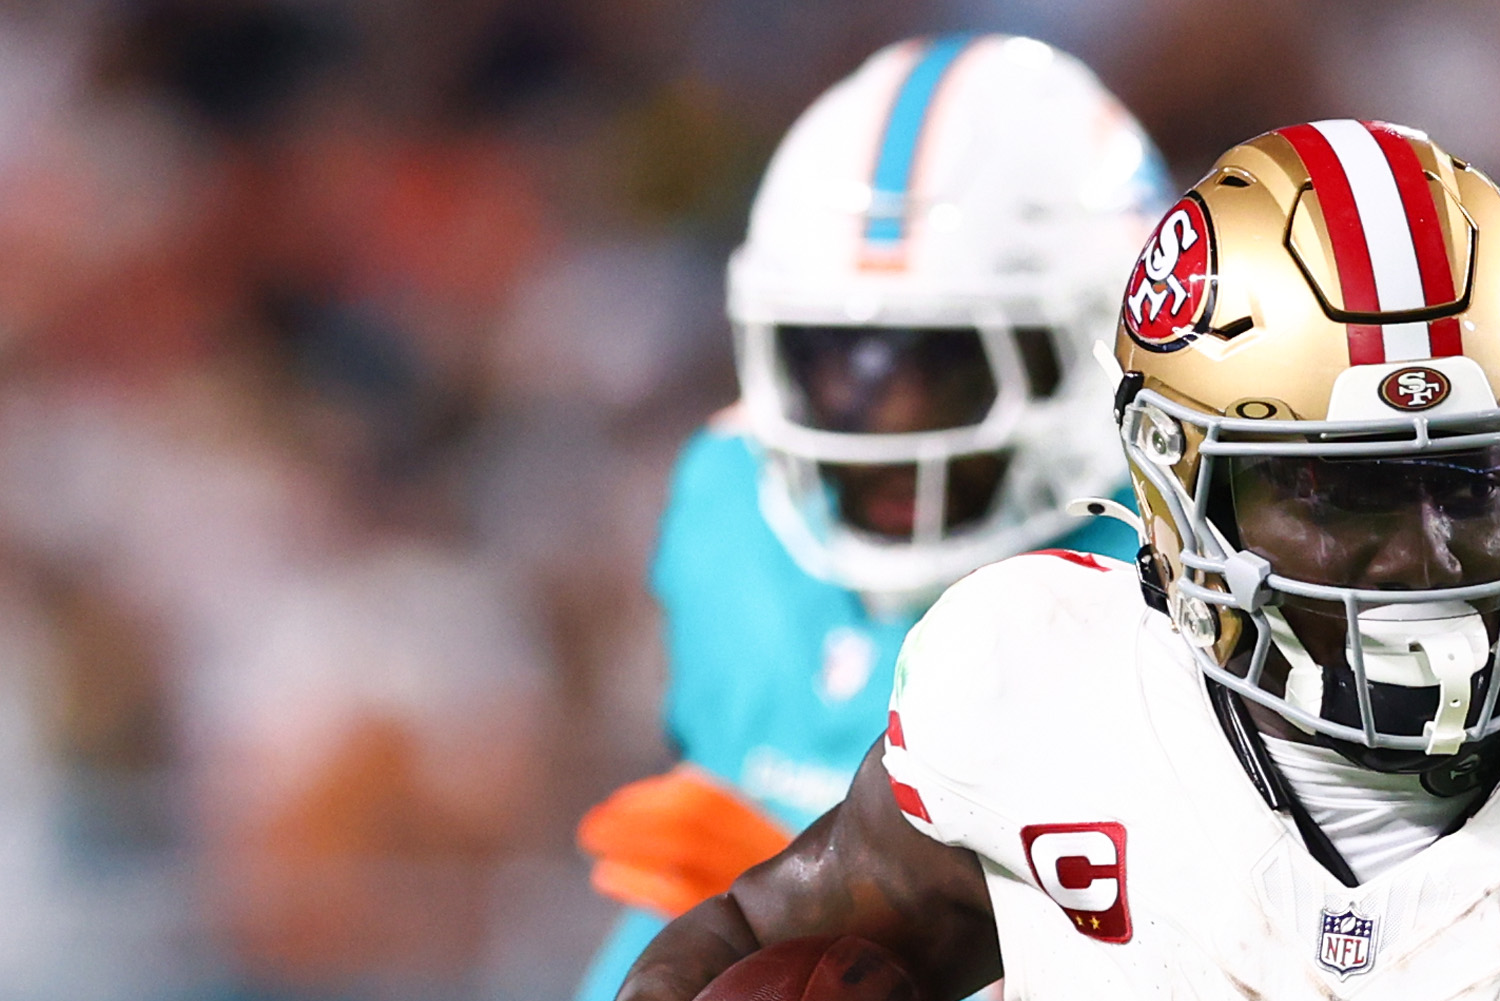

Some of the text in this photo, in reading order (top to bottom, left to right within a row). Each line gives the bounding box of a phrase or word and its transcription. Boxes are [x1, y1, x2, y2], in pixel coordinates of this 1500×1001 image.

[1128, 209, 1199, 325] SF
[1398, 371, 1440, 406] SF
[1030, 830, 1119, 913] C
[1325, 936, 1365, 968] NFL
